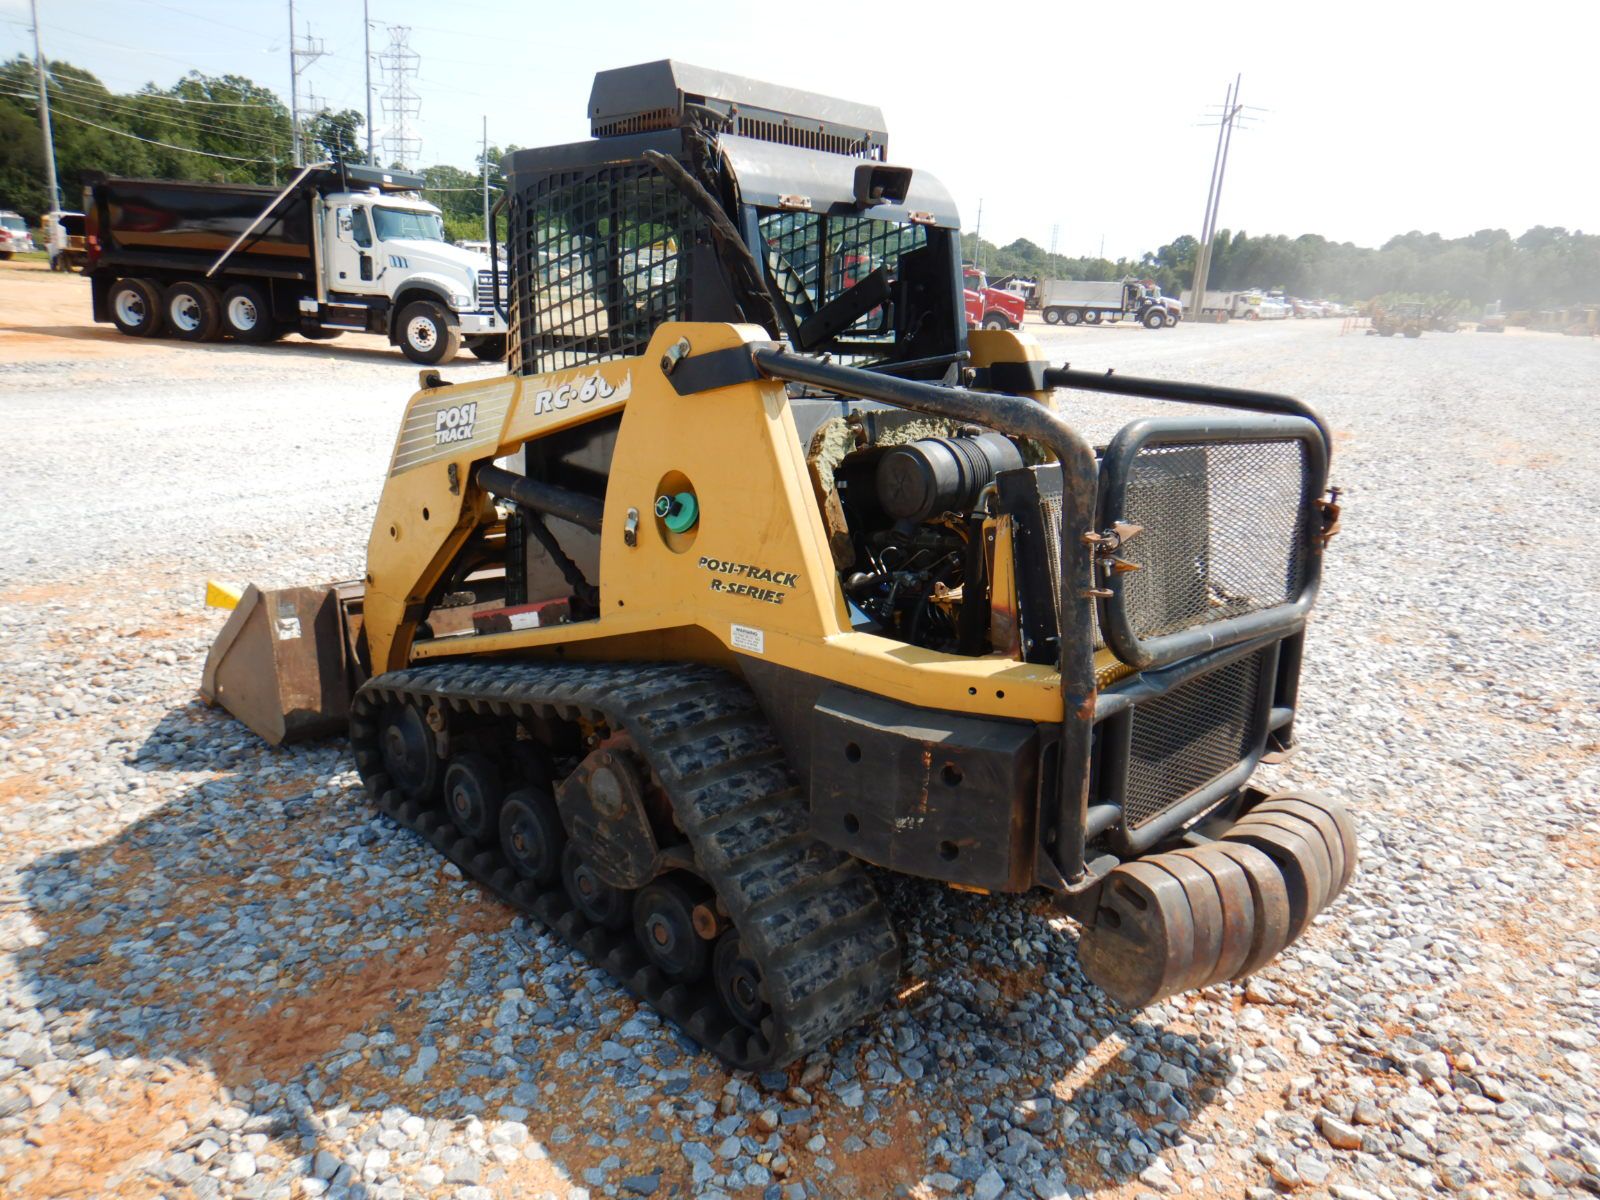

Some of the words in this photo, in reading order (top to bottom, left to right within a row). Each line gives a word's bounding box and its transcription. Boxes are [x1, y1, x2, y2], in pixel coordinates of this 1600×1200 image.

[435, 401, 477, 432] POSI
[434, 423, 474, 445] TRACK
[698, 556, 800, 588] POSI-TRACK
[711, 578, 785, 605] R-SERIES
